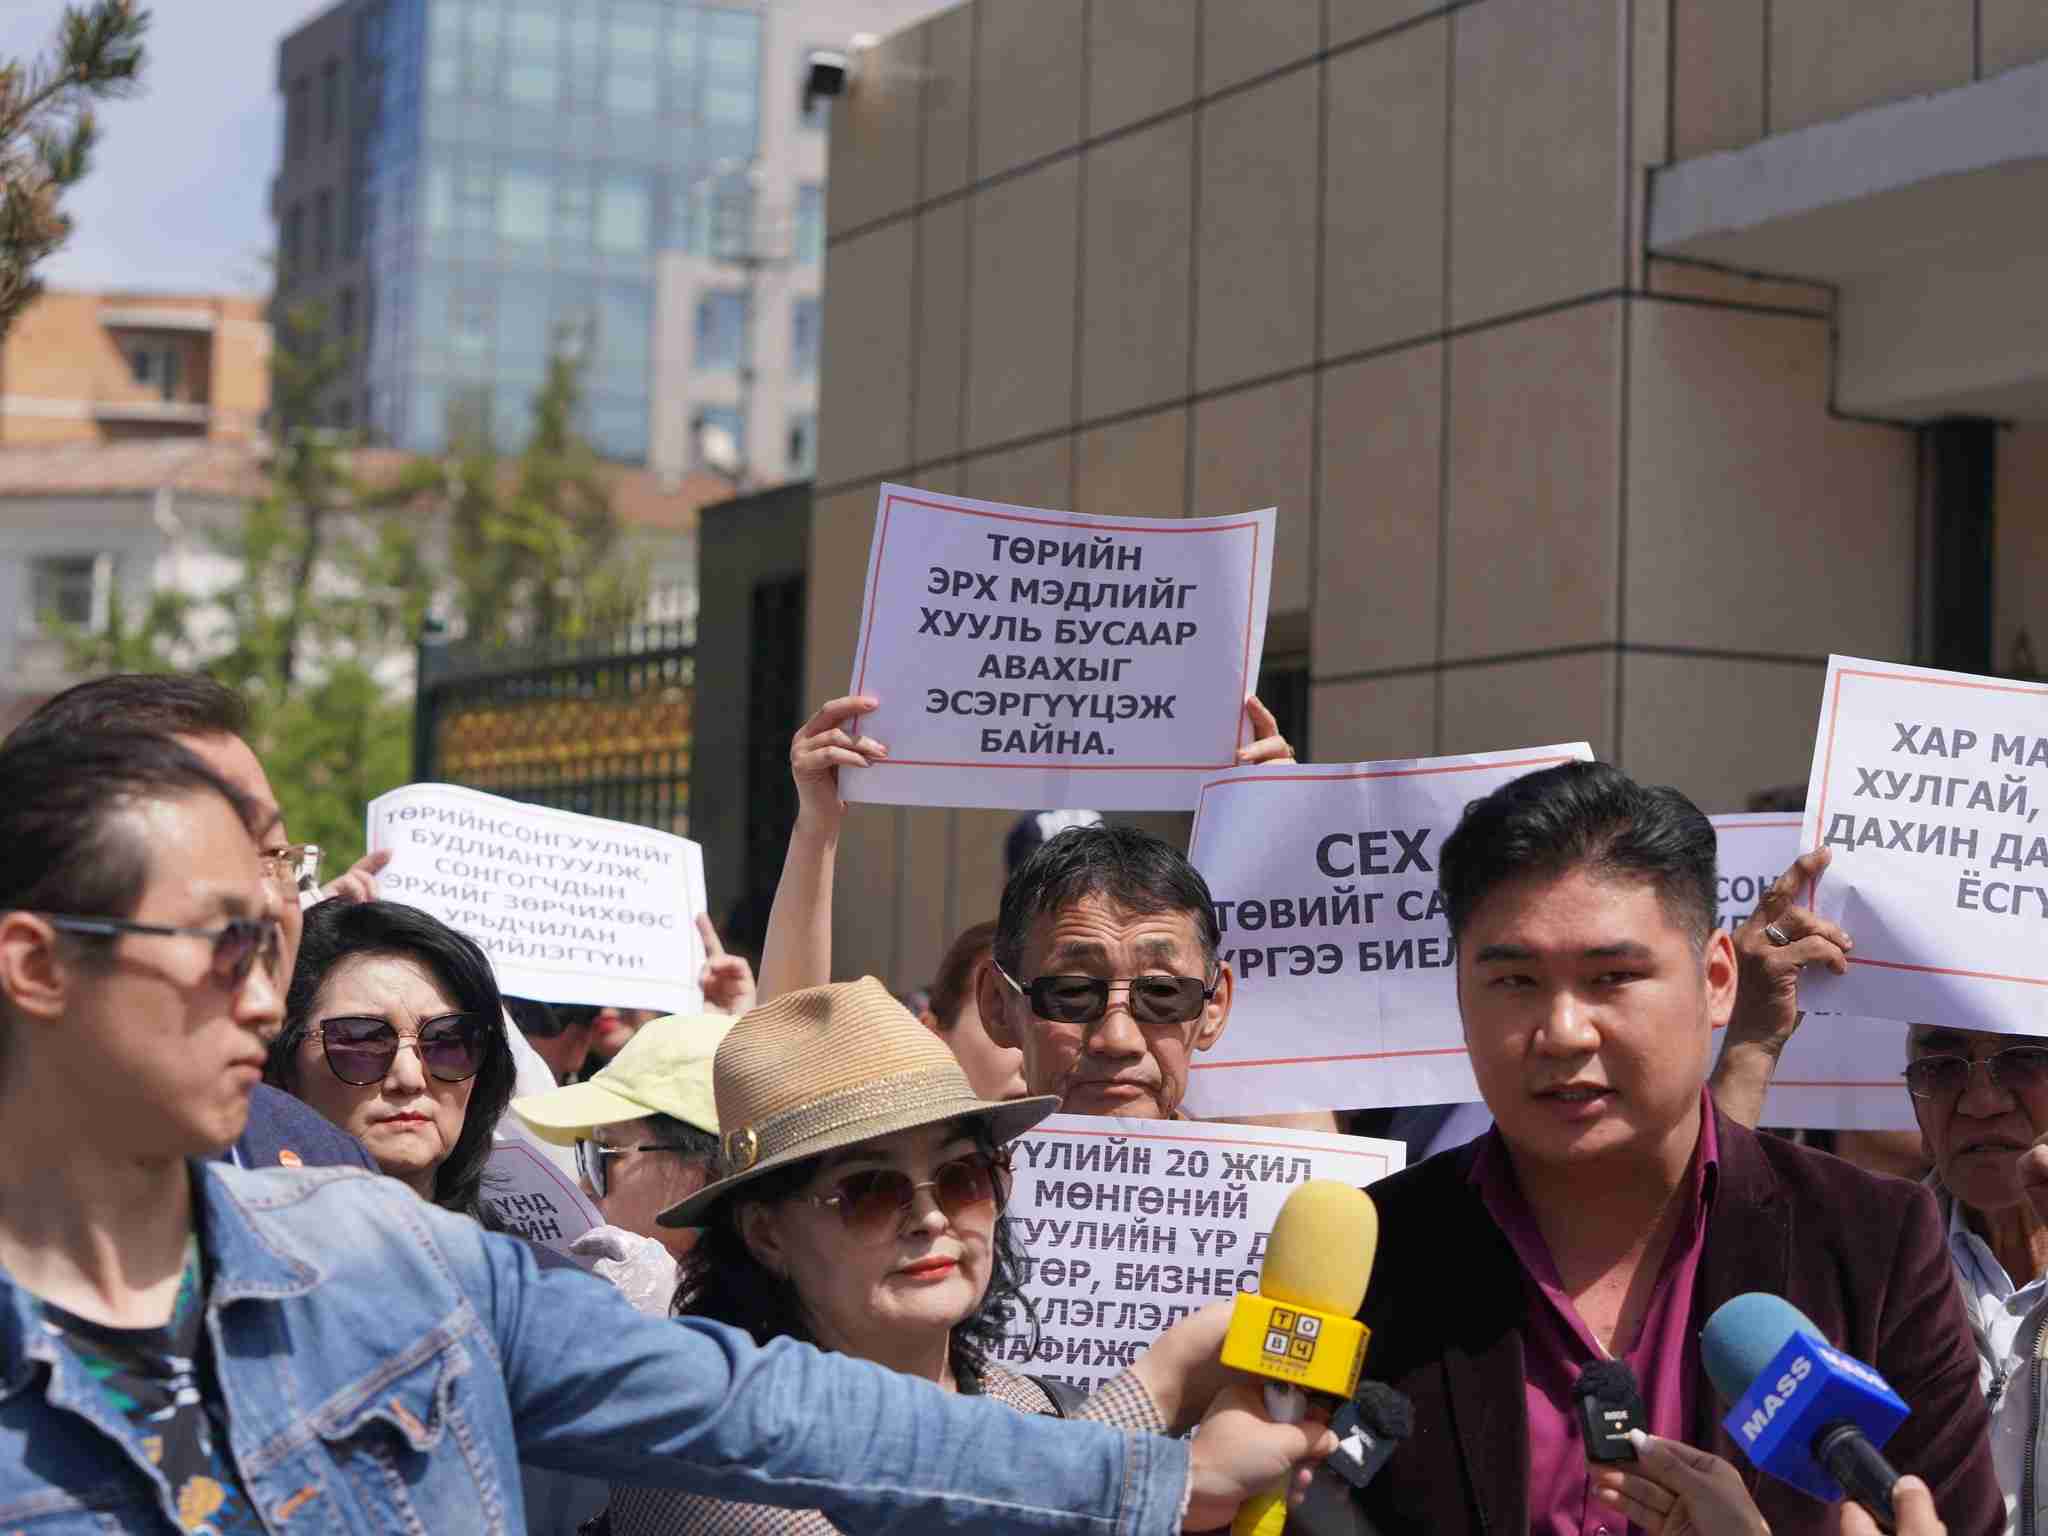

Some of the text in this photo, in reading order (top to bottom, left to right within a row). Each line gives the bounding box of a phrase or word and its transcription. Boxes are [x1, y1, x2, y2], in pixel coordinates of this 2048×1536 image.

[986, 533, 1142, 571] ТӨРИЙН
[927, 567, 1198, 612] ЭРХ МЭДЛИЙГ
[918, 607, 1197, 646] ХУУЛЬ БУСААР
[977, 654, 1132, 682] АВАХЫГ
[925, 688, 1176, 724] ЭСЭРГҮҮЦЭЖ
[980, 722, 1116, 756] БАЙНА.
[1891, 722, 1977, 759] ХАР
[1853, 767, 2039, 824] ХУЛГАЙ,
[1316, 828, 1433, 878] СЕХ
[1823, 813, 1978, 860] ДАХИН
[434, 857, 626, 901] СОНГОГЧДЫН
[1212, 885, 1384, 932] ТӨВИЙГ
[482, 936, 644, 969] ИЙЛЭГТҮН!
[1165, 1150, 1208, 1177] 20
[1220, 1151, 1312, 1184] ЖИЛ
[1034, 1180, 1249, 1220] МӨНГӨНИЙ
[1190, 1228, 1238, 1257] ҮР
[1115, 1263, 1260, 1297] БИЗНЕС
[1742, 1356, 1812, 1441] MASS
